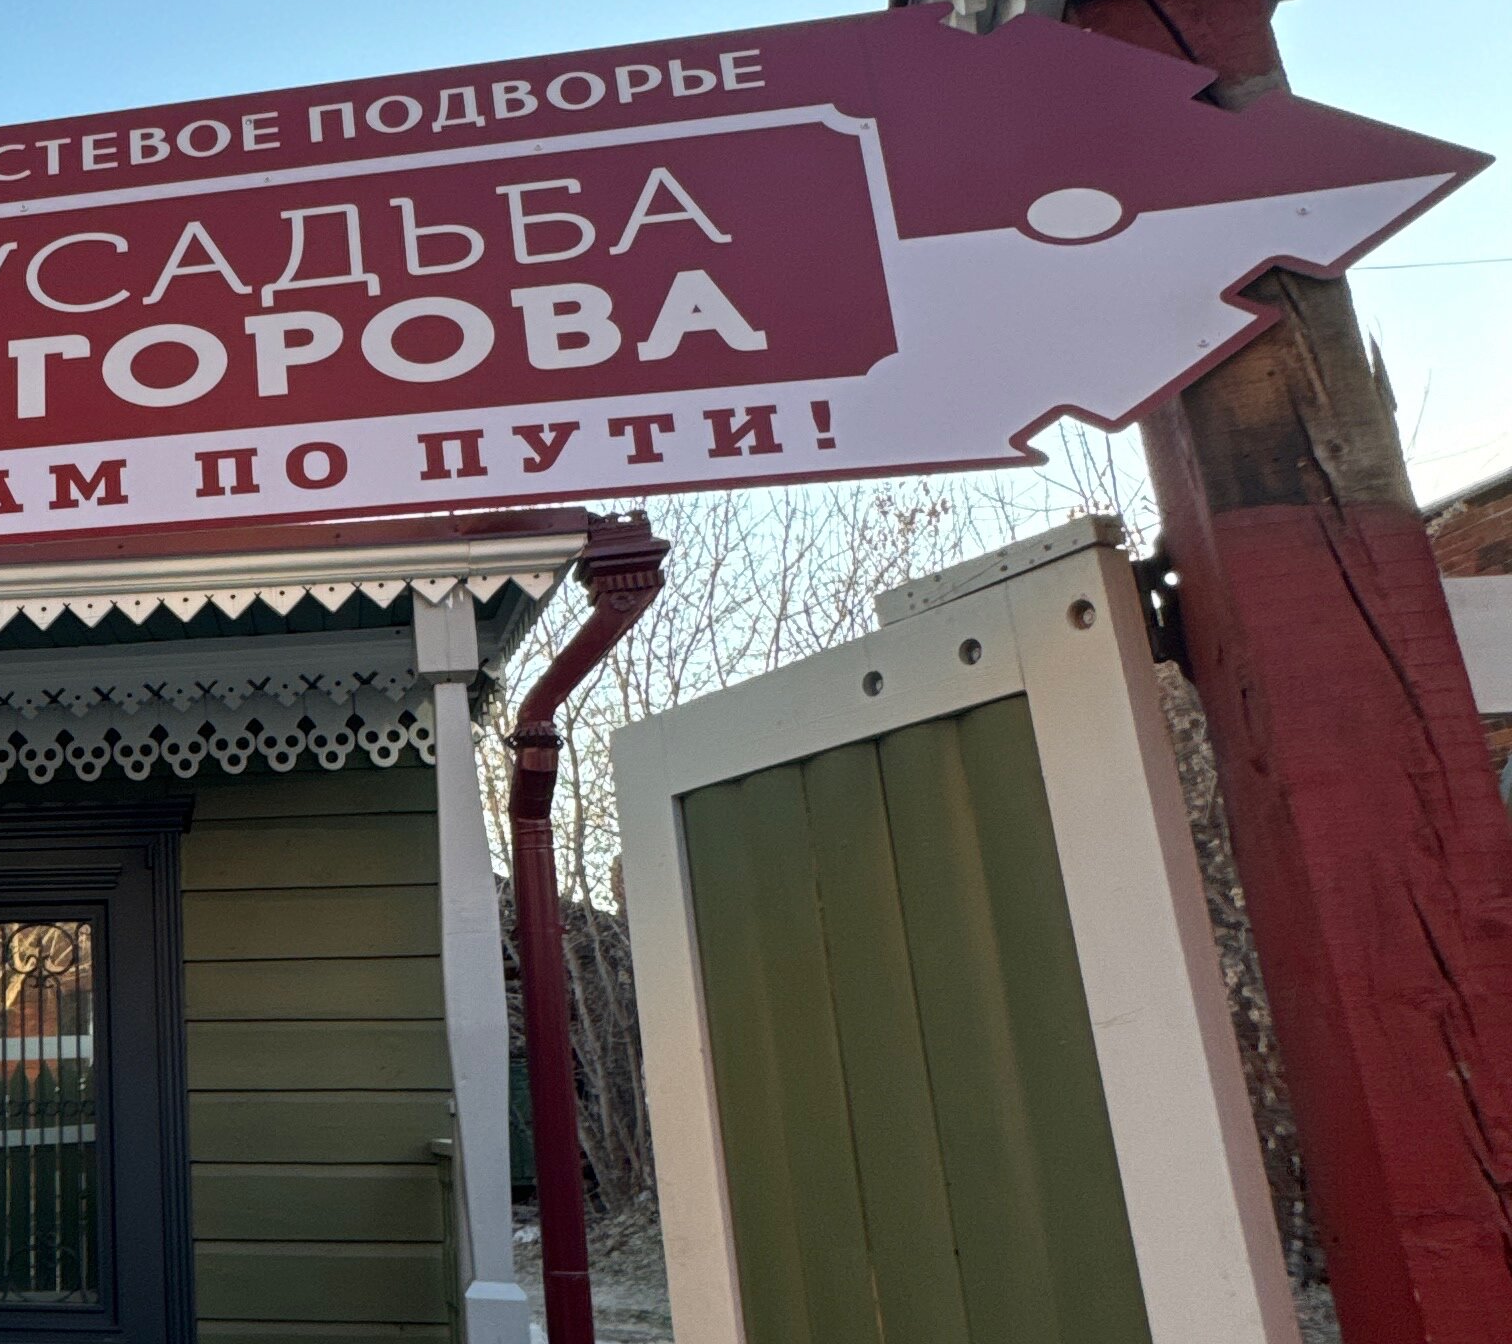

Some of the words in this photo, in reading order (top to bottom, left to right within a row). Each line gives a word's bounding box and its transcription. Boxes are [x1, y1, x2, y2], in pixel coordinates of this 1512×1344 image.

[308, 49, 766, 143] ПОДВОРЬЕ
[194, 441, 349, 498] ПО
[416, 400, 834, 481] ПУТИ!
